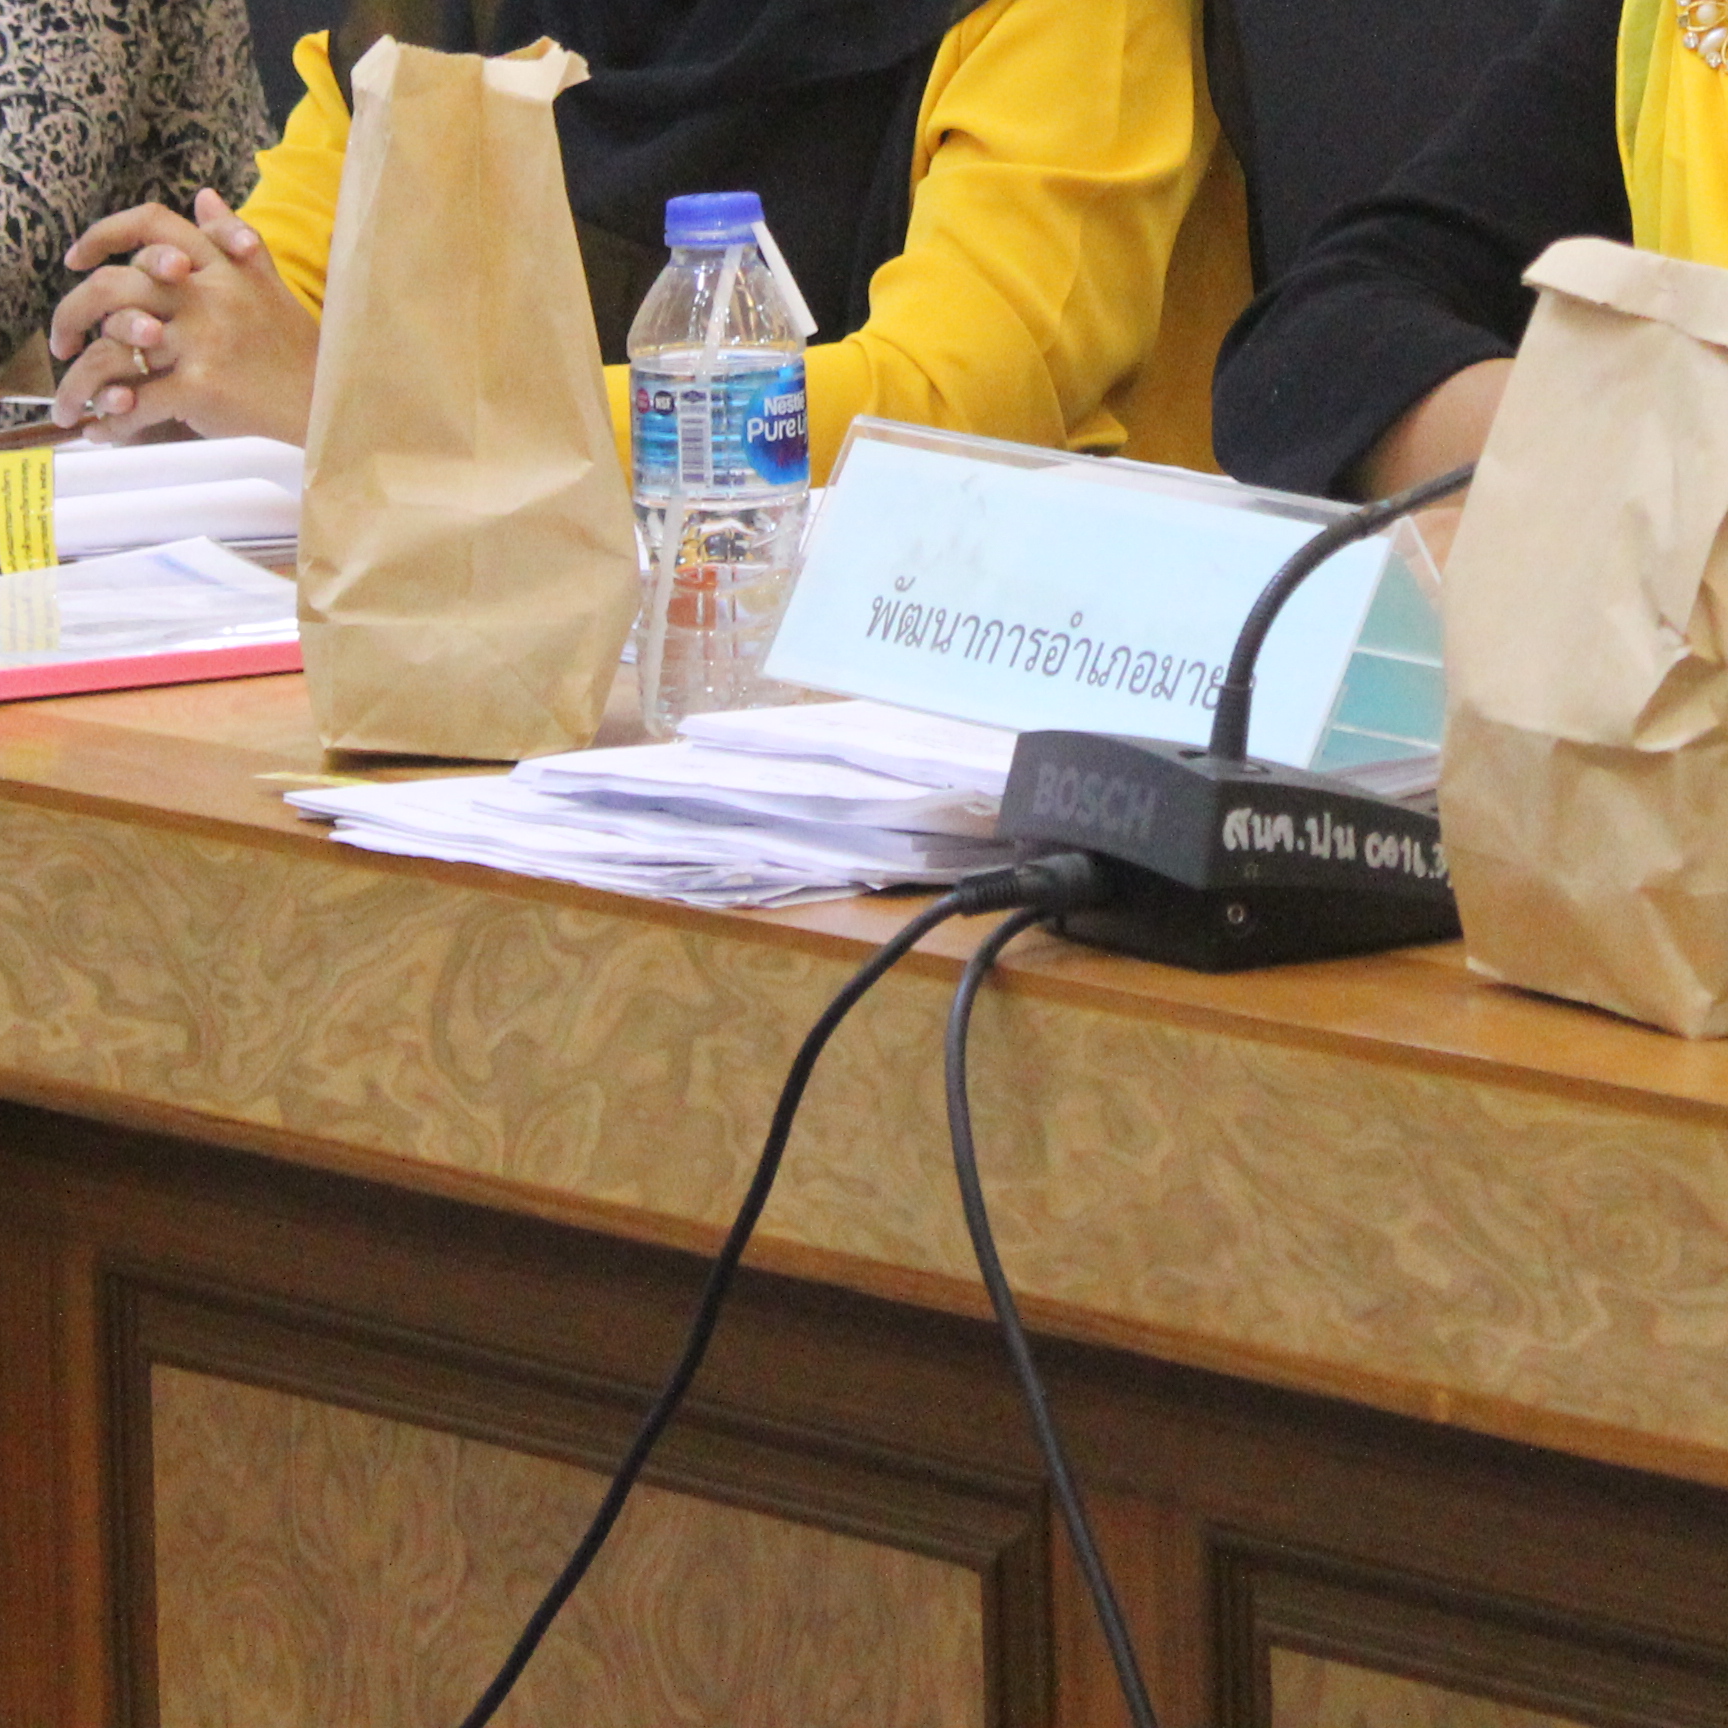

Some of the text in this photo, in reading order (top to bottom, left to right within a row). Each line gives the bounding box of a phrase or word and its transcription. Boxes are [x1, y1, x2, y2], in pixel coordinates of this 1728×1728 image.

[866, 576, 1257, 711] พัฒนาการอำเภอมาย
[1032, 761, 1159, 842] BOSCH
